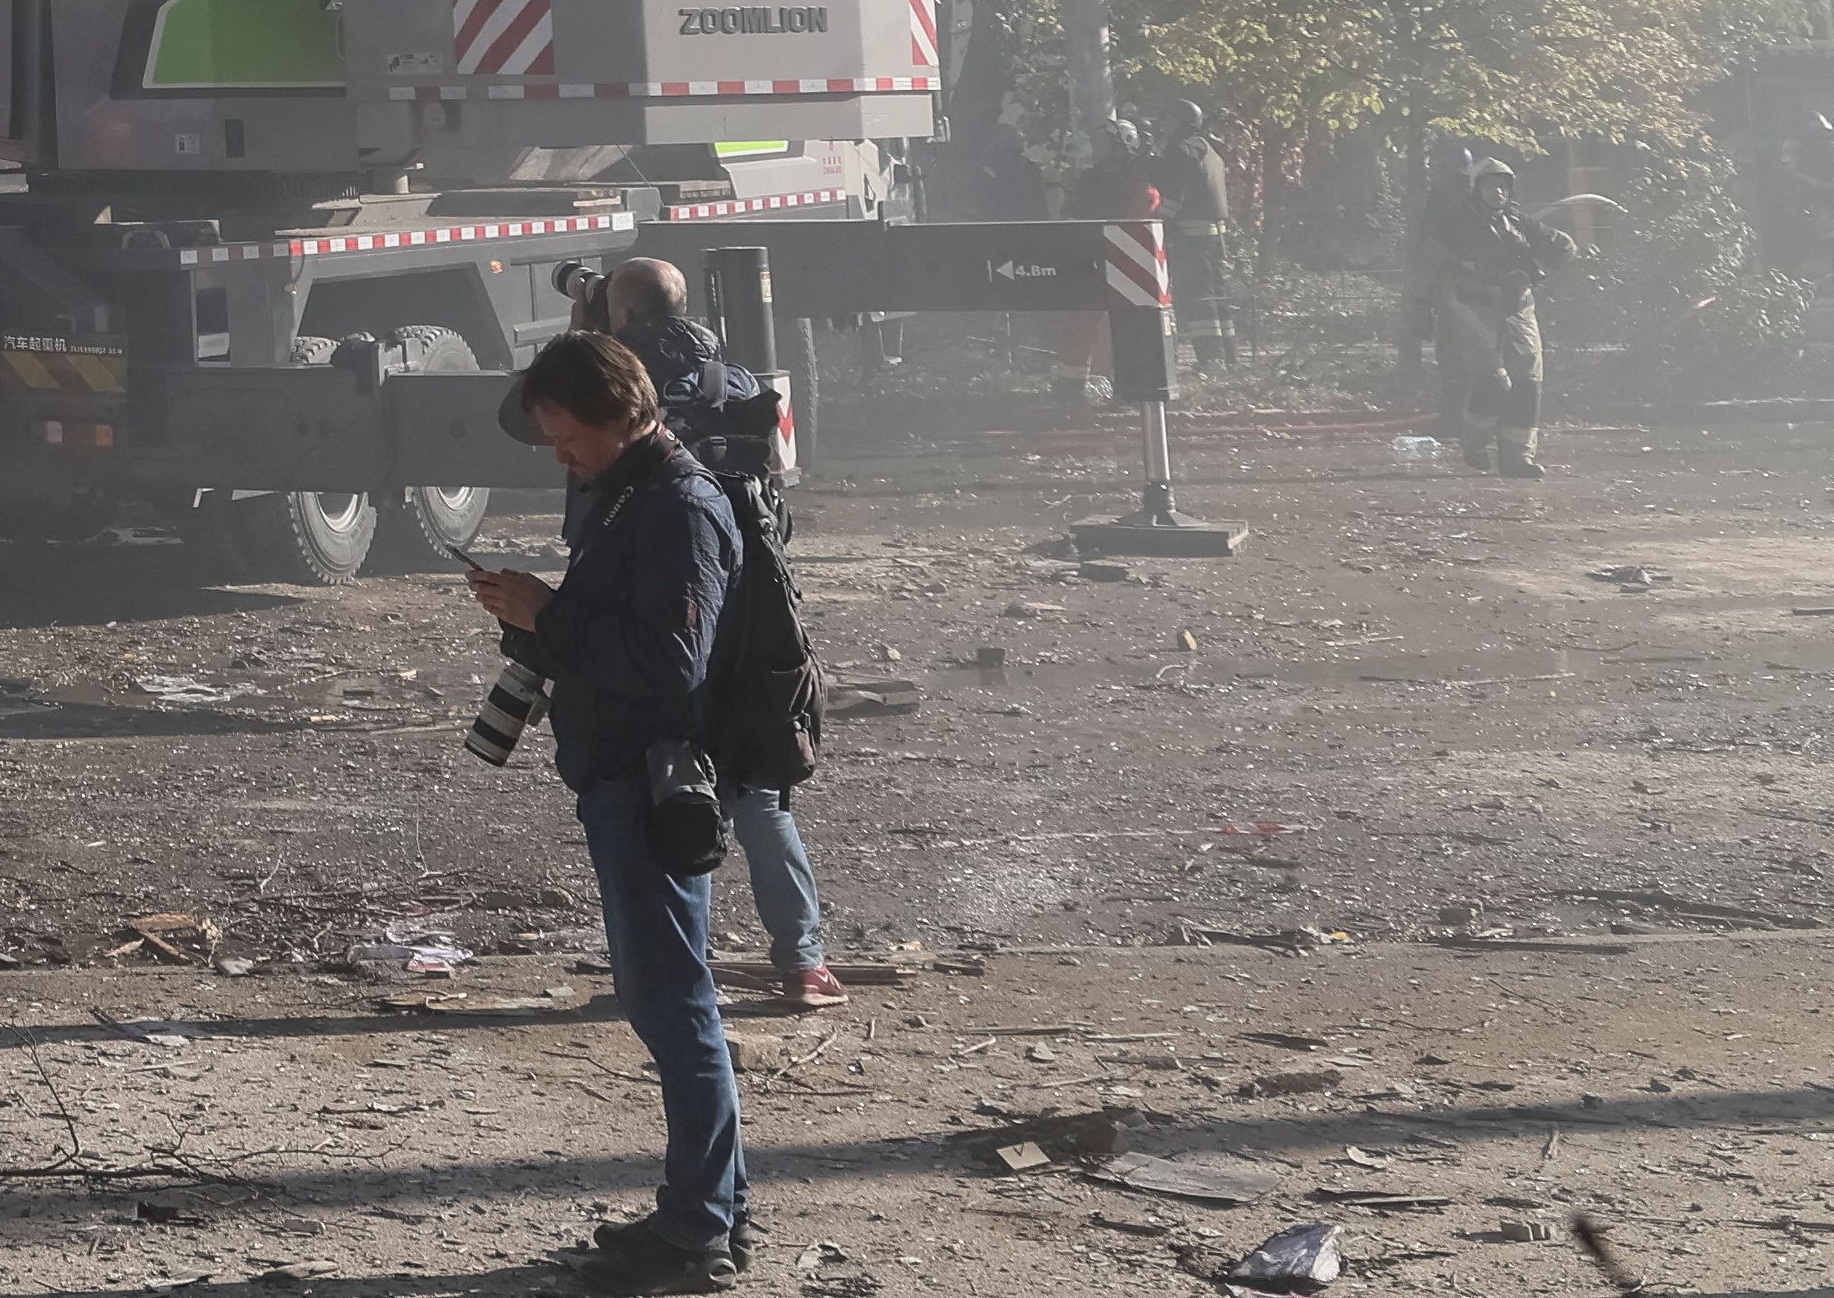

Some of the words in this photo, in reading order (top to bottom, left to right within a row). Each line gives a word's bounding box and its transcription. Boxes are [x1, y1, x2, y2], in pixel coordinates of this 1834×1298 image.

[678, 6, 829, 36] ZOOMLION
[3, 335, 67, 352] 汽车起重机
